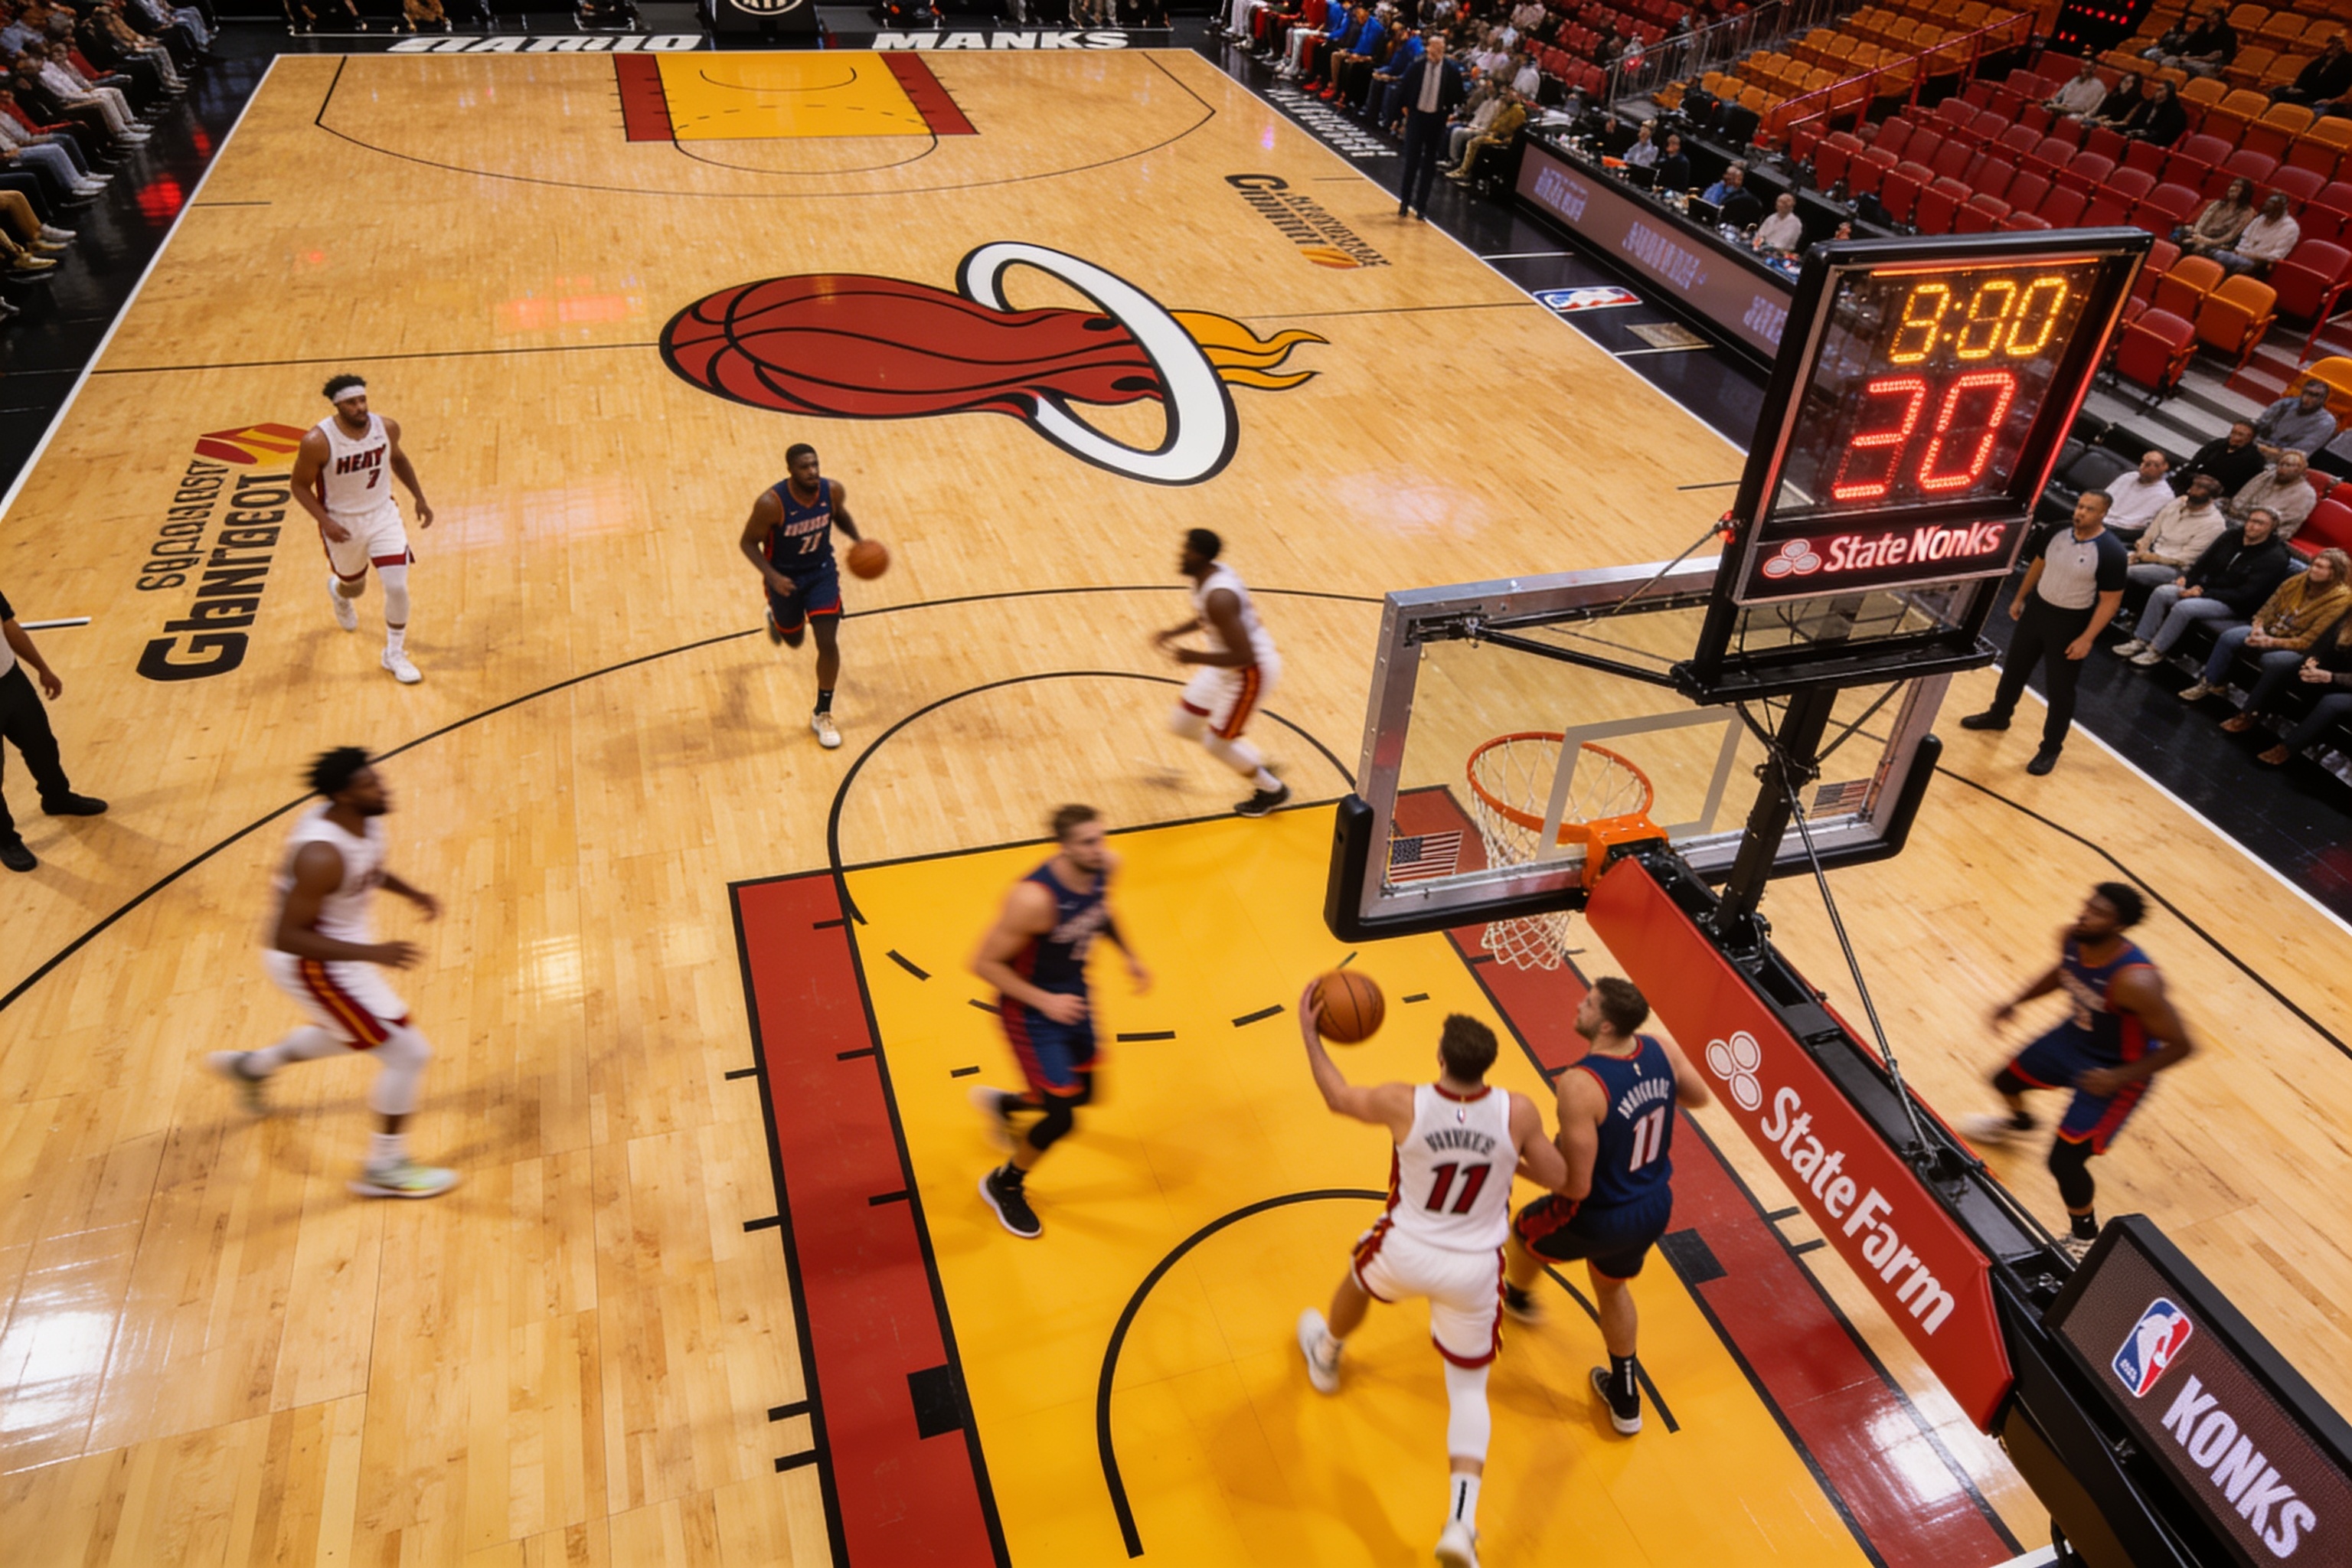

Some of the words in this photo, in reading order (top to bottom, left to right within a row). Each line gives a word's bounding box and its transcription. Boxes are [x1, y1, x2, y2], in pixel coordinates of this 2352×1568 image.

[871, 31, 1129, 49] MANKS
[336, 443, 386, 475] HEAT
[366, 469, 381, 488] 7
[1629, 1106, 1665, 1173] 11
[1425, 1161, 1491, 1215] 11
[2161, 1374, 2317, 1559] KONKS
